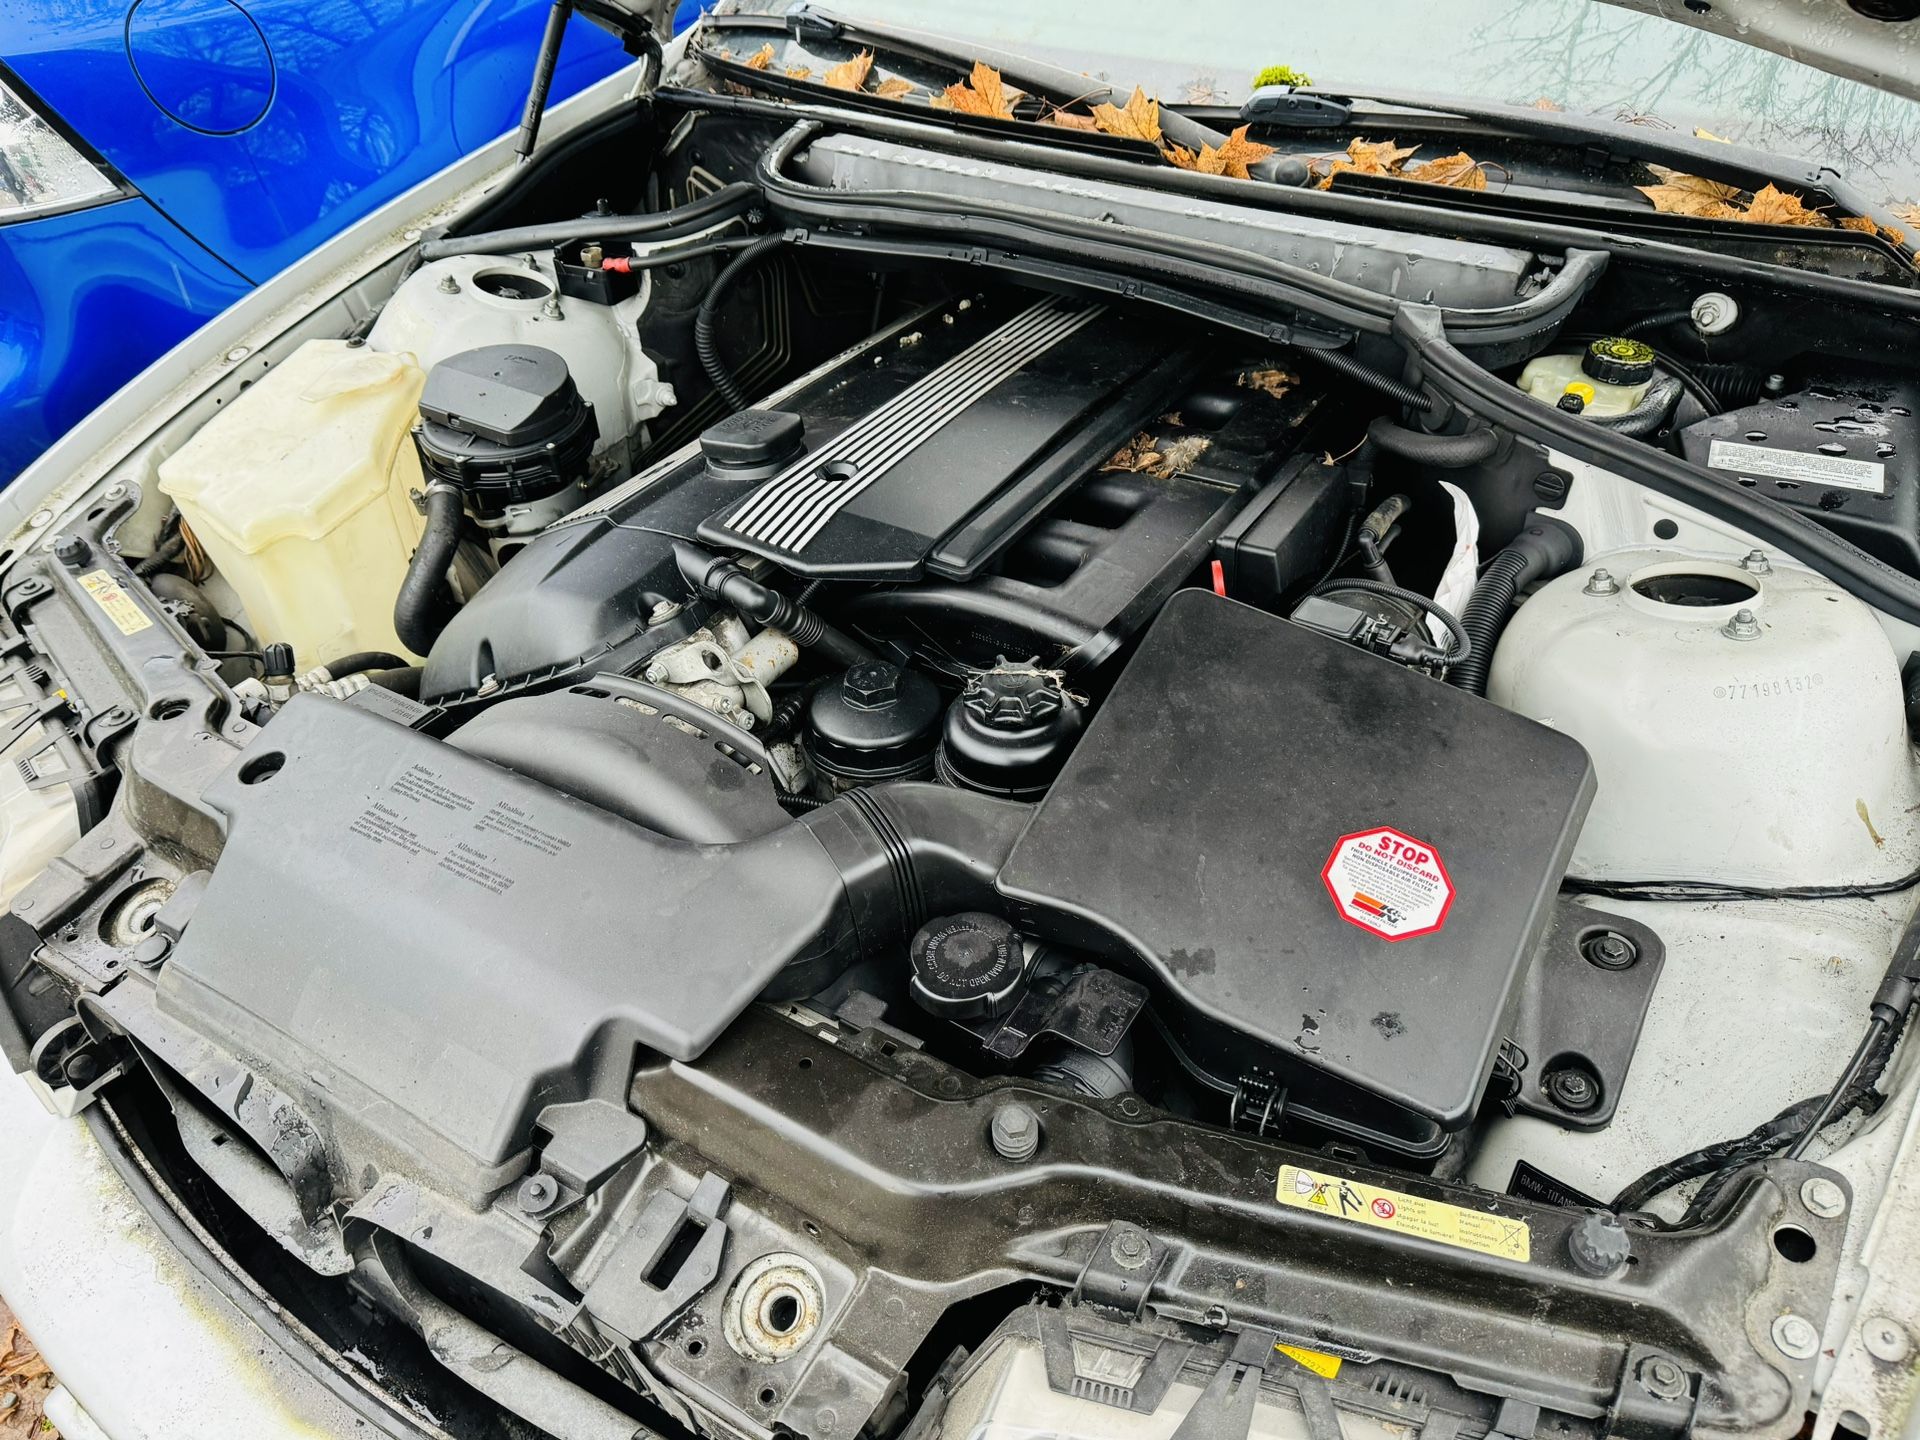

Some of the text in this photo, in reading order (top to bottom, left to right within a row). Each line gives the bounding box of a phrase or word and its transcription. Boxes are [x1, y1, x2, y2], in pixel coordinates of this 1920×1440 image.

[1350, 847, 1363, 855] THIS
[1365, 852, 1388, 867] VEHICLE
[1389, 863, 1417, 880] EQUIPPED
[1418, 878, 1434, 887] WITH
[1358, 842, 1440, 883] DO NOT DISCARD
[1378, 836, 1429, 865] STOP
[1400, 875, 1412, 883] AIR
[1412, 880, 1433, 892] FILTER
